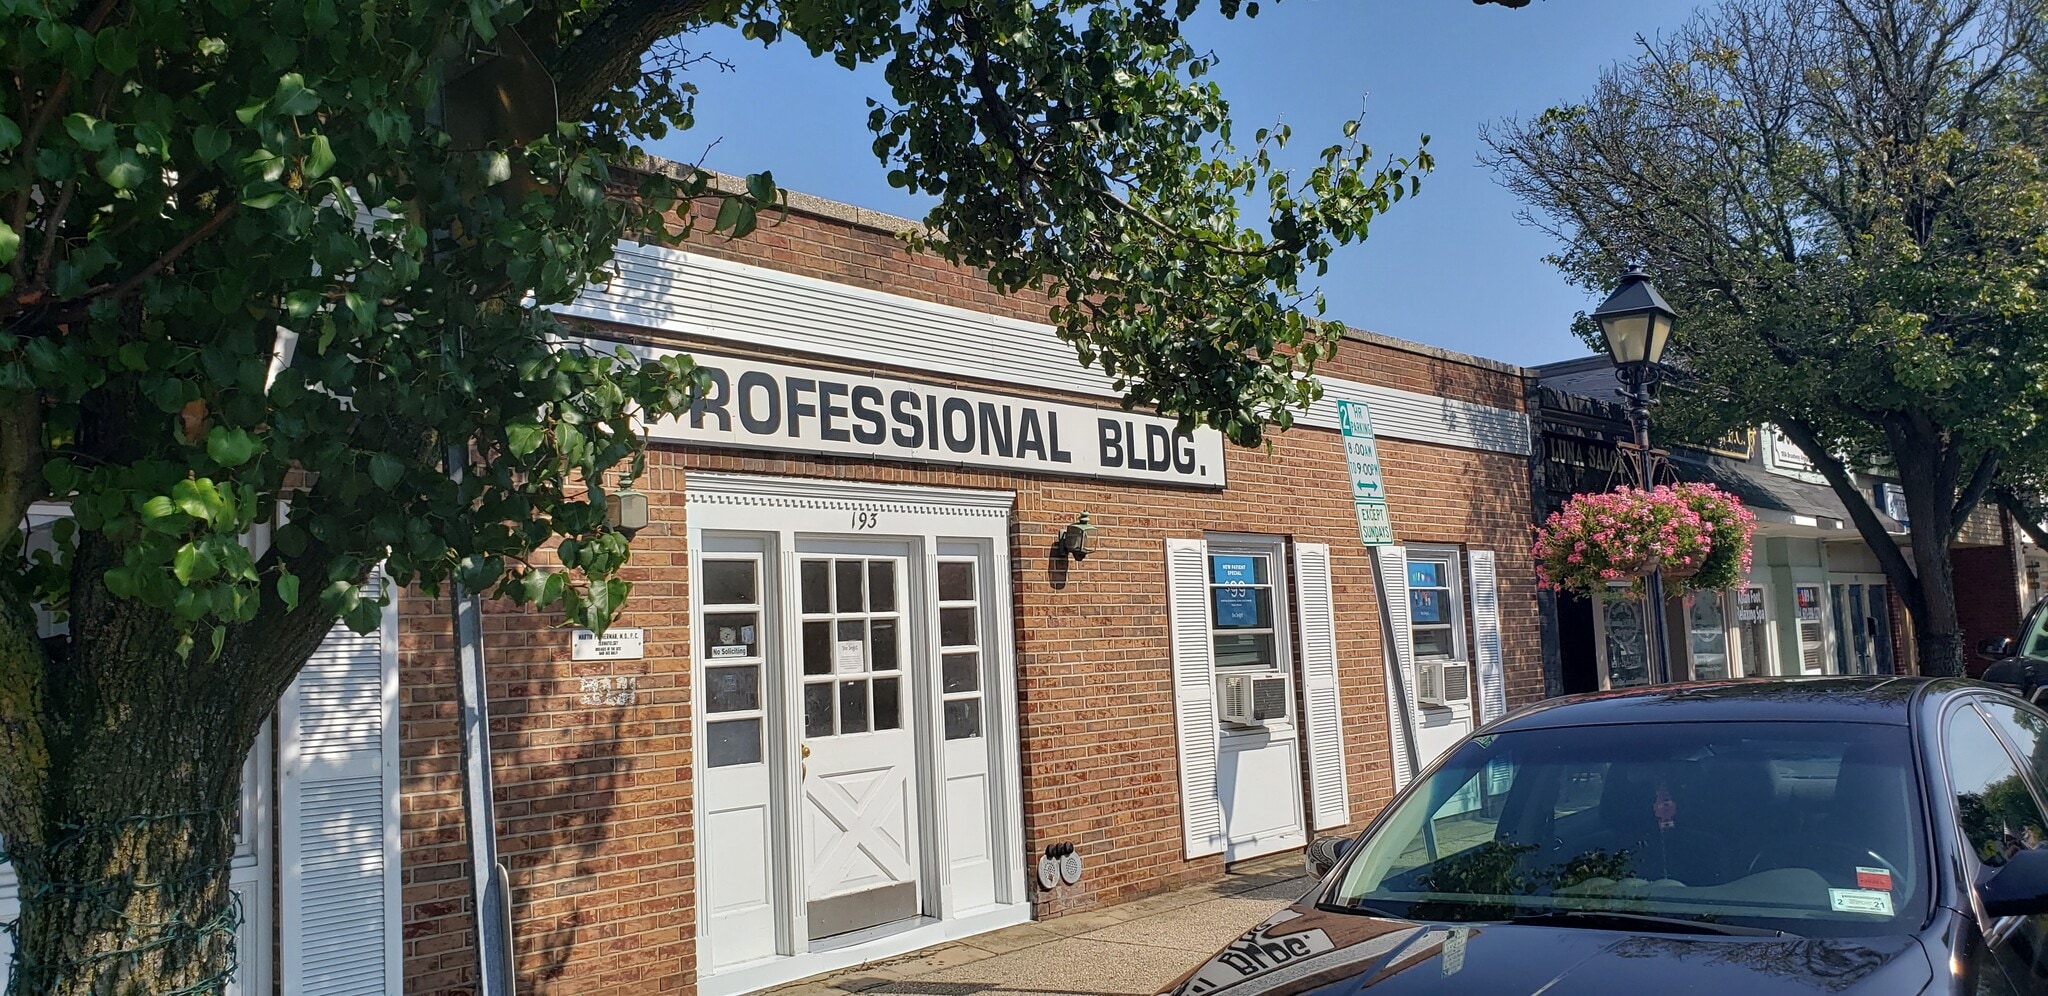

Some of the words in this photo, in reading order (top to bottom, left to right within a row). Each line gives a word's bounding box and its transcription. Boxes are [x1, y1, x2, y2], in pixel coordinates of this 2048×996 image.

[641, 358, 1071, 463] ROFESSIONAL
[1098, 416, 1206, 476] BLDG.
[1340, 405, 1350, 430] 2
[1353, 406, 1363, 419] HR
[1350, 421, 1371, 435] PARKING
[1550, 438, 1585, 467] LUNA
[851, 511, 878, 530] 193
[1362, 508, 1383, 521] EXCEPT
[1363, 526, 1389, 538] SUNDAYS
[1750, 589, 1762, 603] Foot
[1756, 605, 1765, 624] Spa
[721, 647, 746, 656] Soliciting
